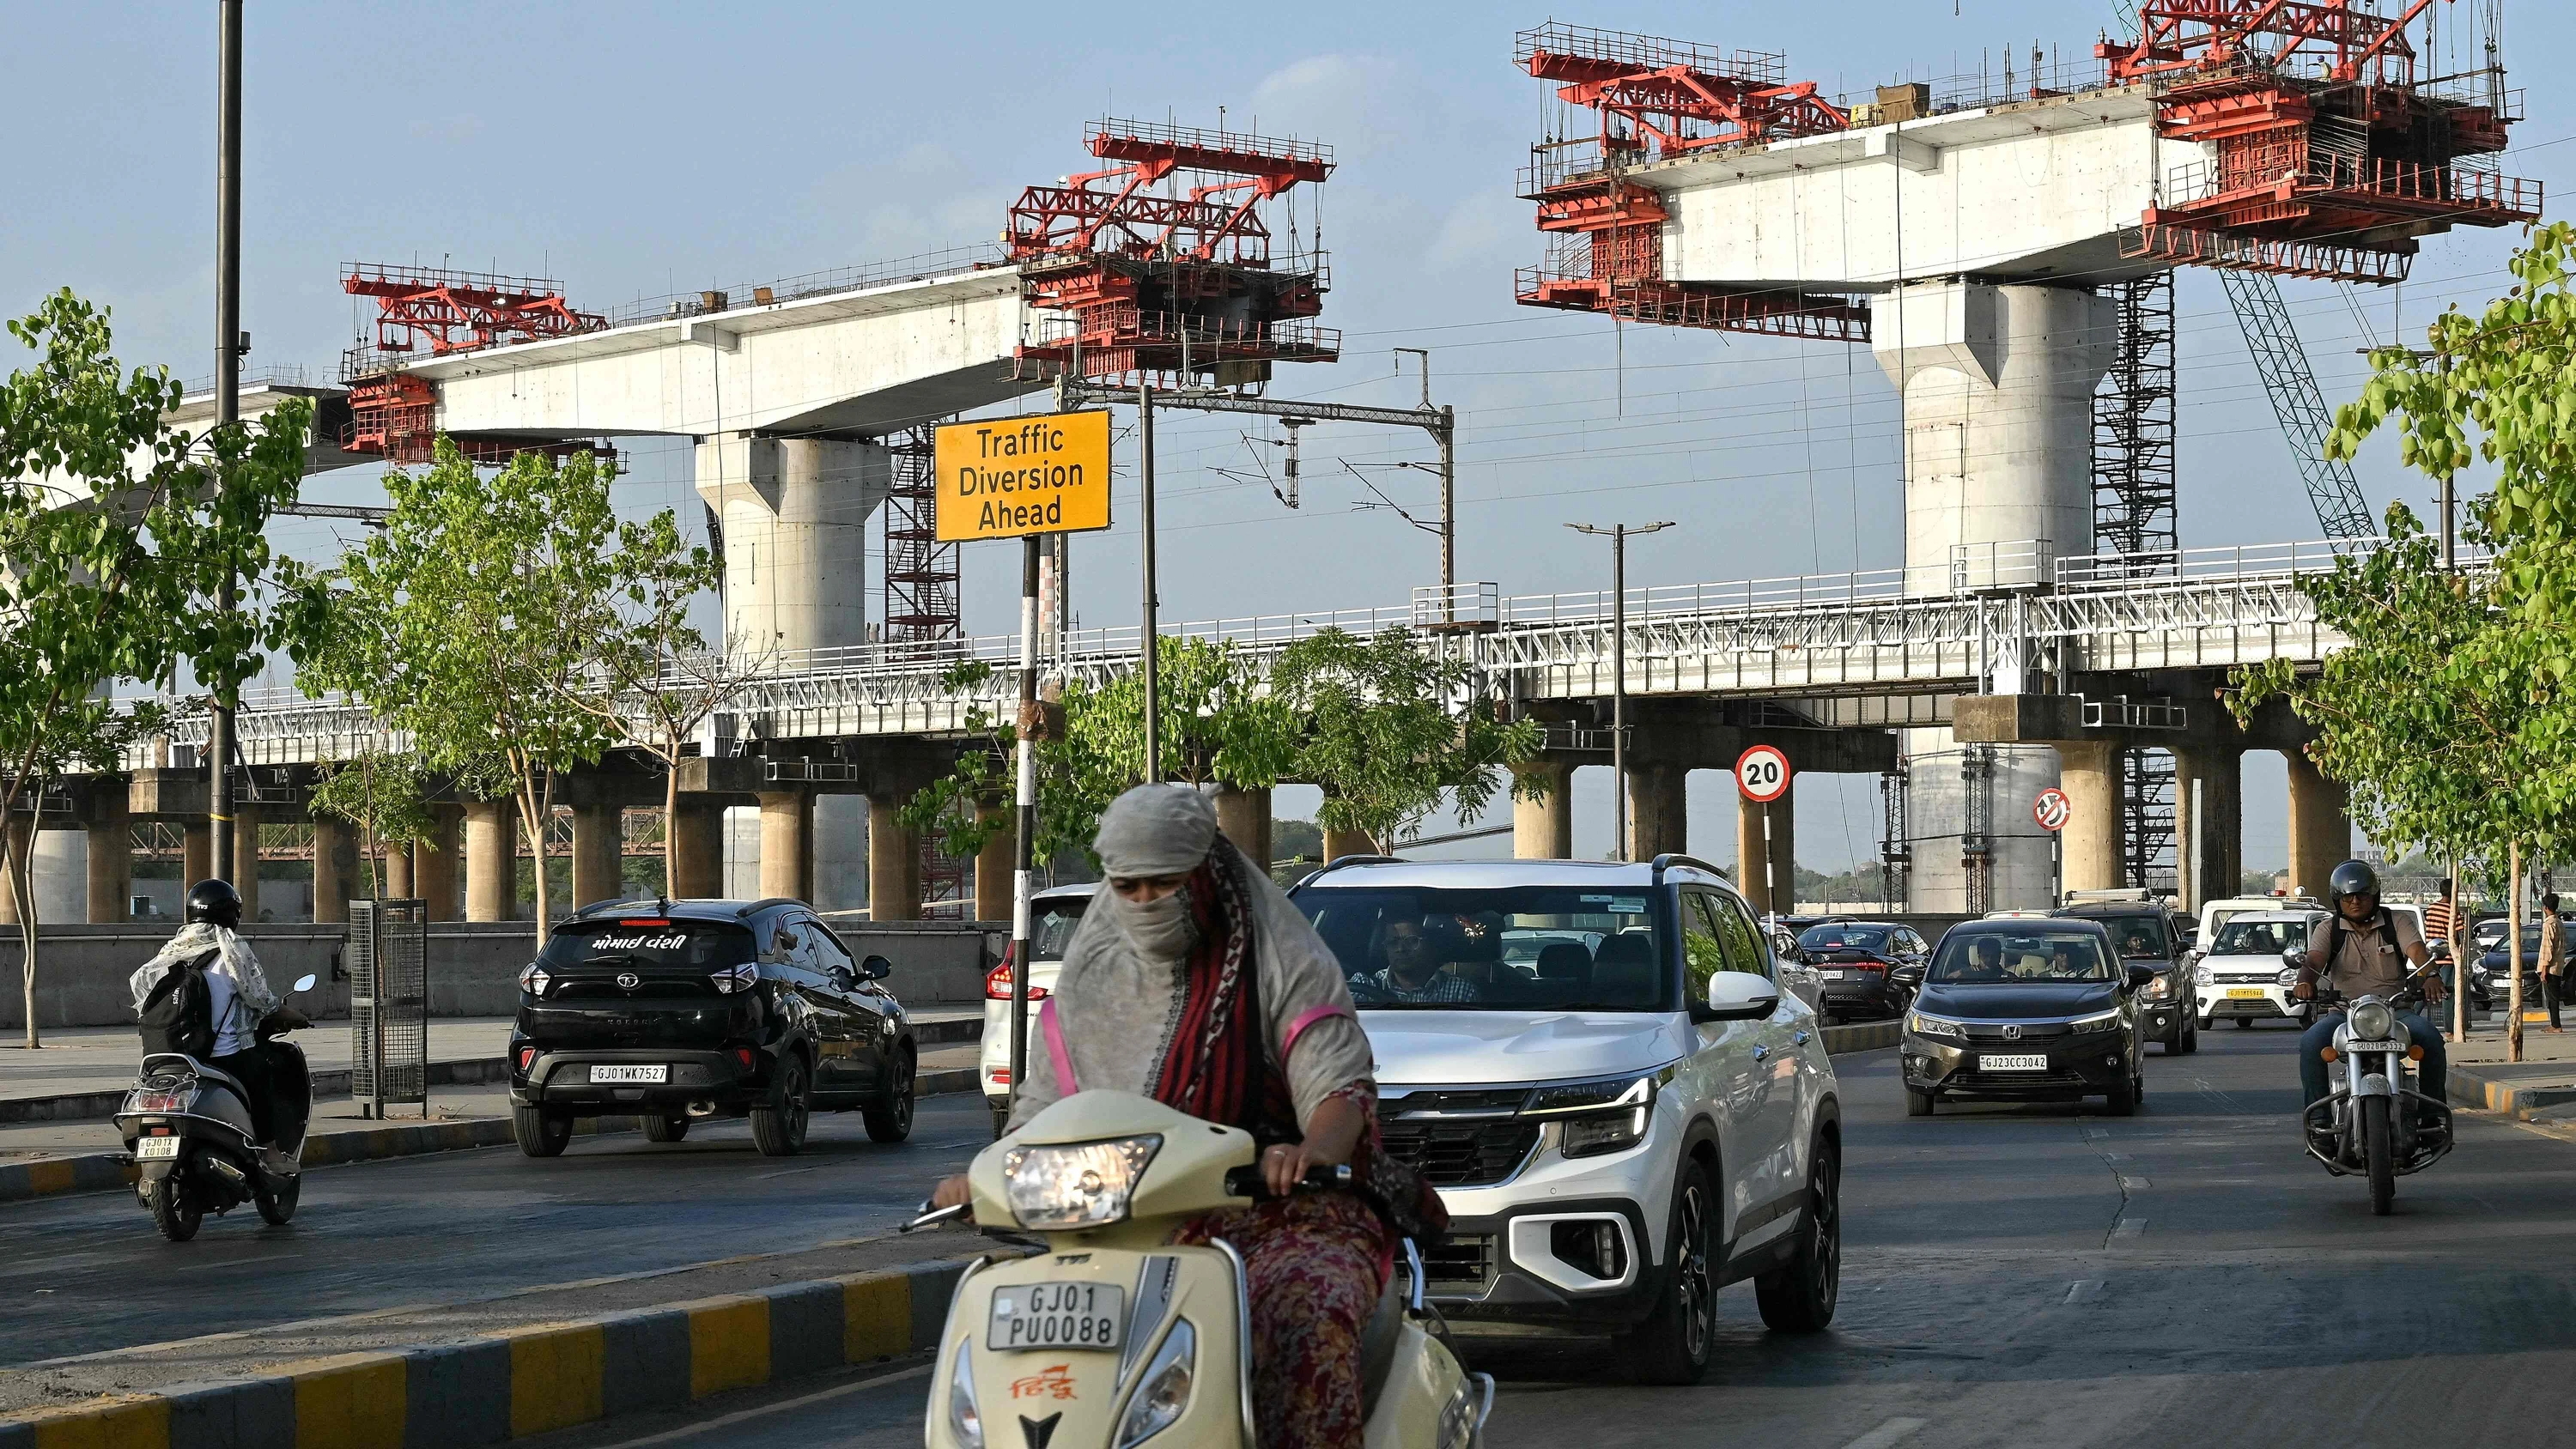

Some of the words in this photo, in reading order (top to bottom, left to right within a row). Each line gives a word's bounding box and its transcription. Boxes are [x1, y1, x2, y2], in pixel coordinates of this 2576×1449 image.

[976, 423, 1064, 458] Traffic
[960, 460, 1084, 496] Diversion
[978, 495, 1061, 530] Ahead
[1747, 761, 1778, 785] 20
[598, 1067, 665, 1080] GJ01WK7527
[1986, 1057, 2045, 1068] GJ23CC3042
[144, 1147, 172, 1156] K0108
[146, 1137, 173, 1148] GJ01X
[1030, 1285, 1096, 1313] GJ01
[1009, 1316, 1112, 1345] PU0088
